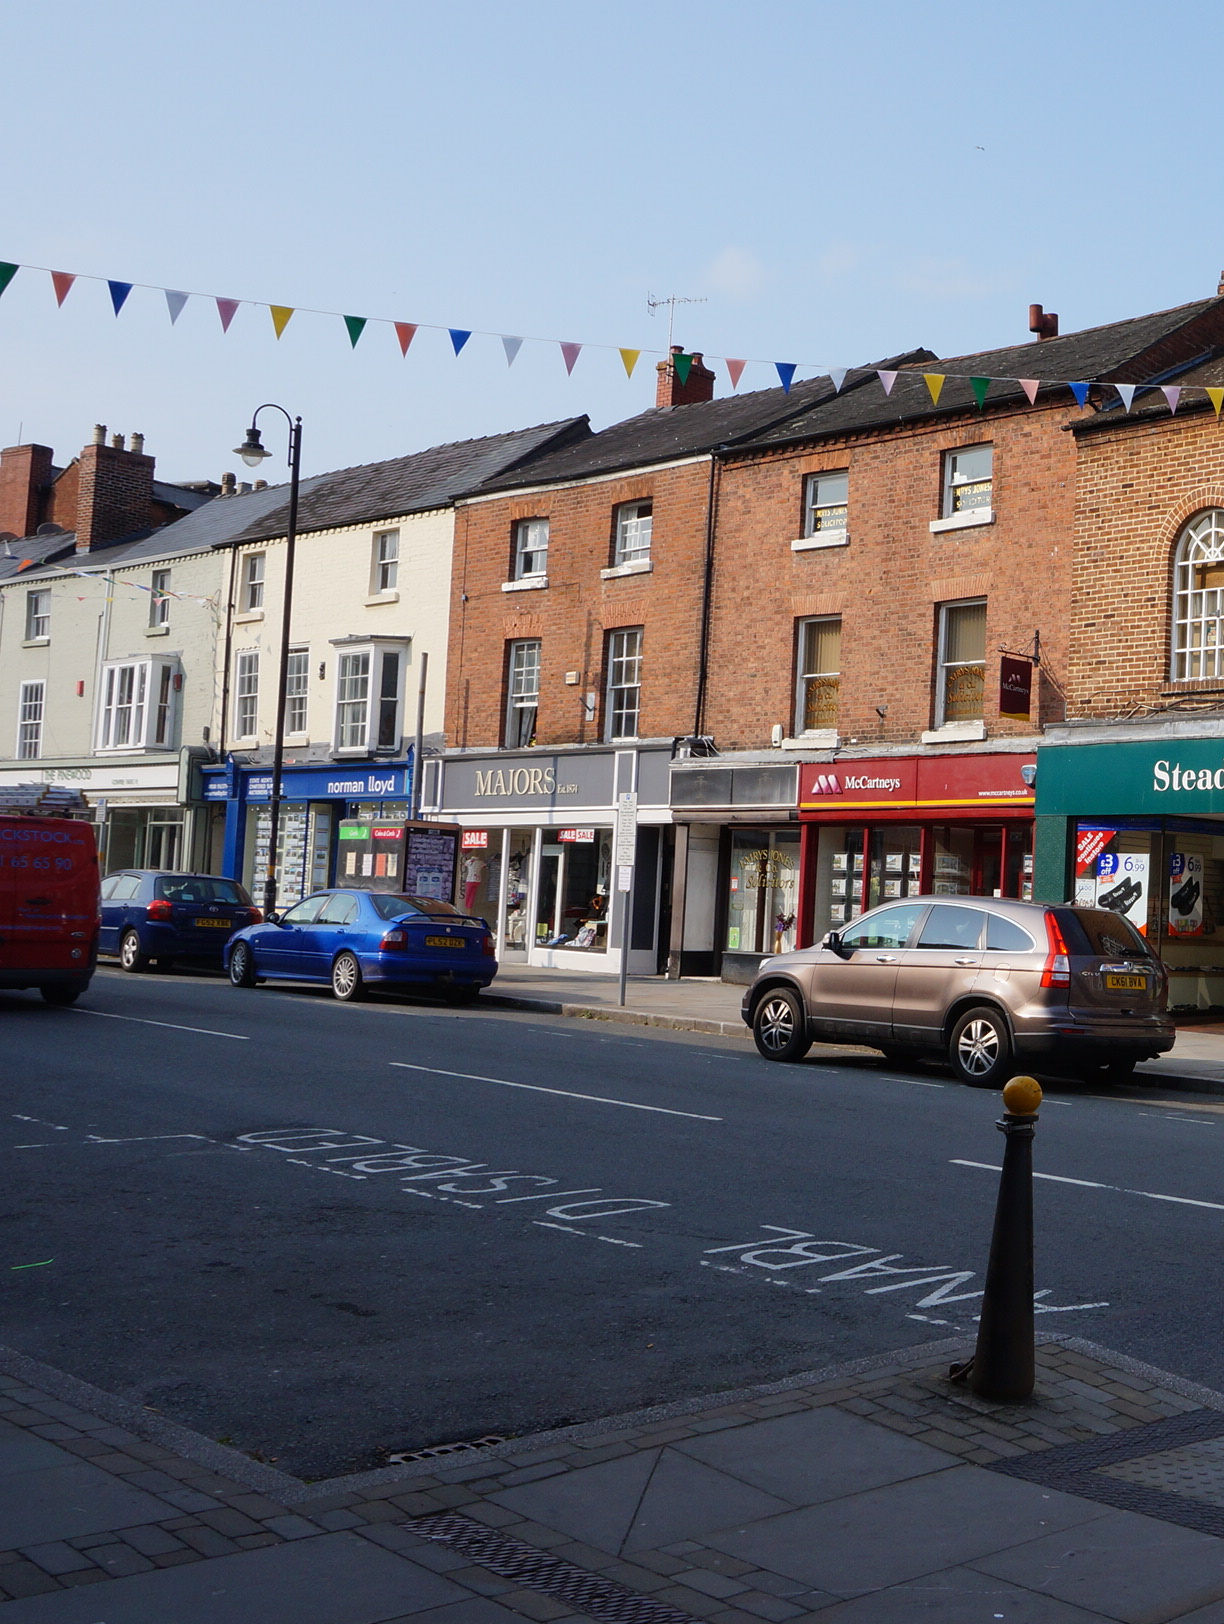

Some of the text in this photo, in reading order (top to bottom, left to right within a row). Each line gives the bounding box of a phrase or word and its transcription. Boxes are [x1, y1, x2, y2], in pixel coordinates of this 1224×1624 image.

[328, 775, 395, 795] norman lloyd
[474, 767, 556, 796] MAJORS
[844, 775, 901, 792] McCartneys
[464, 832, 488, 845] SALE
[560, 830, 576, 840] SALE
[577, 830, 594, 840] SALE
[1077, 832, 1094, 851] SALE
[1077, 831, 1104, 863] continues
[10, 855, 28, 868] 65
[32, 857, 51, 869] 65
[1100, 854, 1113, 868] £3
[1124, 856, 1145, 872] 6.99
[1172, 854, 1181, 867] £3
[1188, 856, 1202, 873] 6.99
[746, 873, 795, 889] Solicitors
[1111, 976, 1142, 988] CK61 BVA
[237, 1128, 671, 1220] DISABLED
